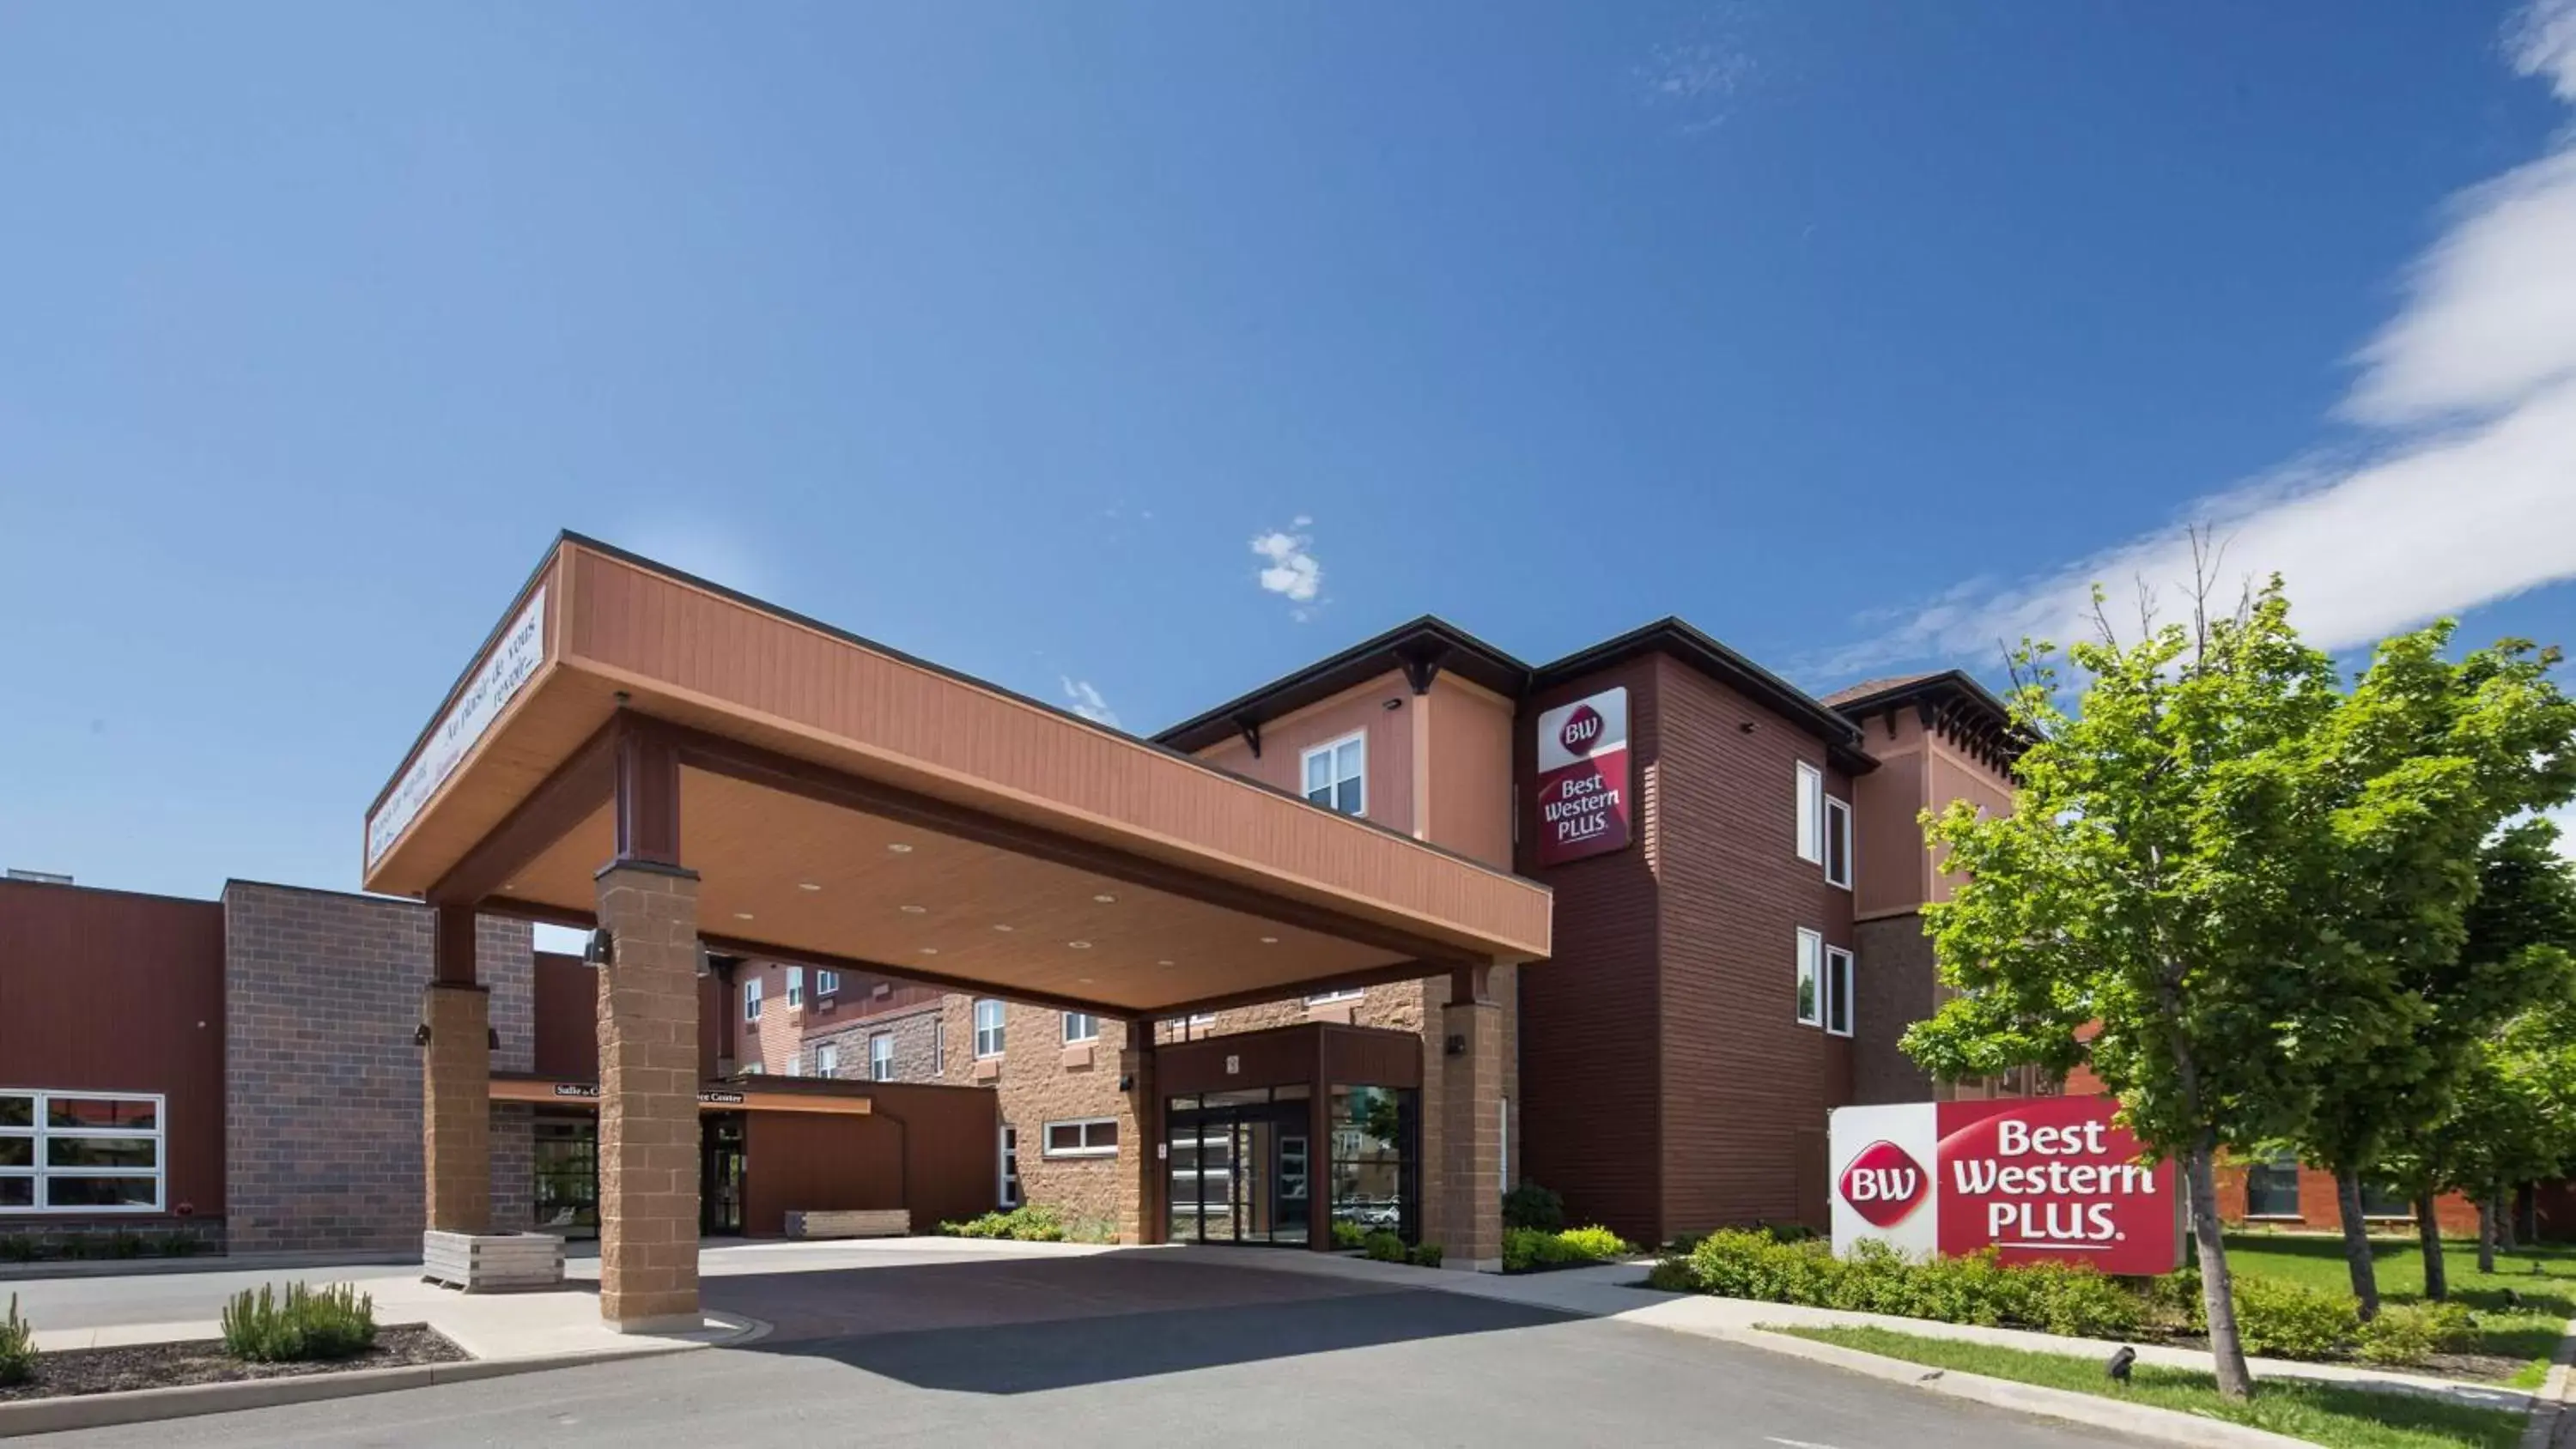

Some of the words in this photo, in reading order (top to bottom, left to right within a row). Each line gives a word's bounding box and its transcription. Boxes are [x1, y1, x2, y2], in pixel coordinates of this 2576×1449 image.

[508, 615, 536, 659] vous
[1564, 716, 1598, 744] BW
[1562, 773, 1604, 798] Best
[1545, 789, 1619, 822] Western
[1998, 1119, 2107, 1156] Best
[1851, 1168, 1916, 1202] BW
[1953, 1160, 2156, 1195] Western
